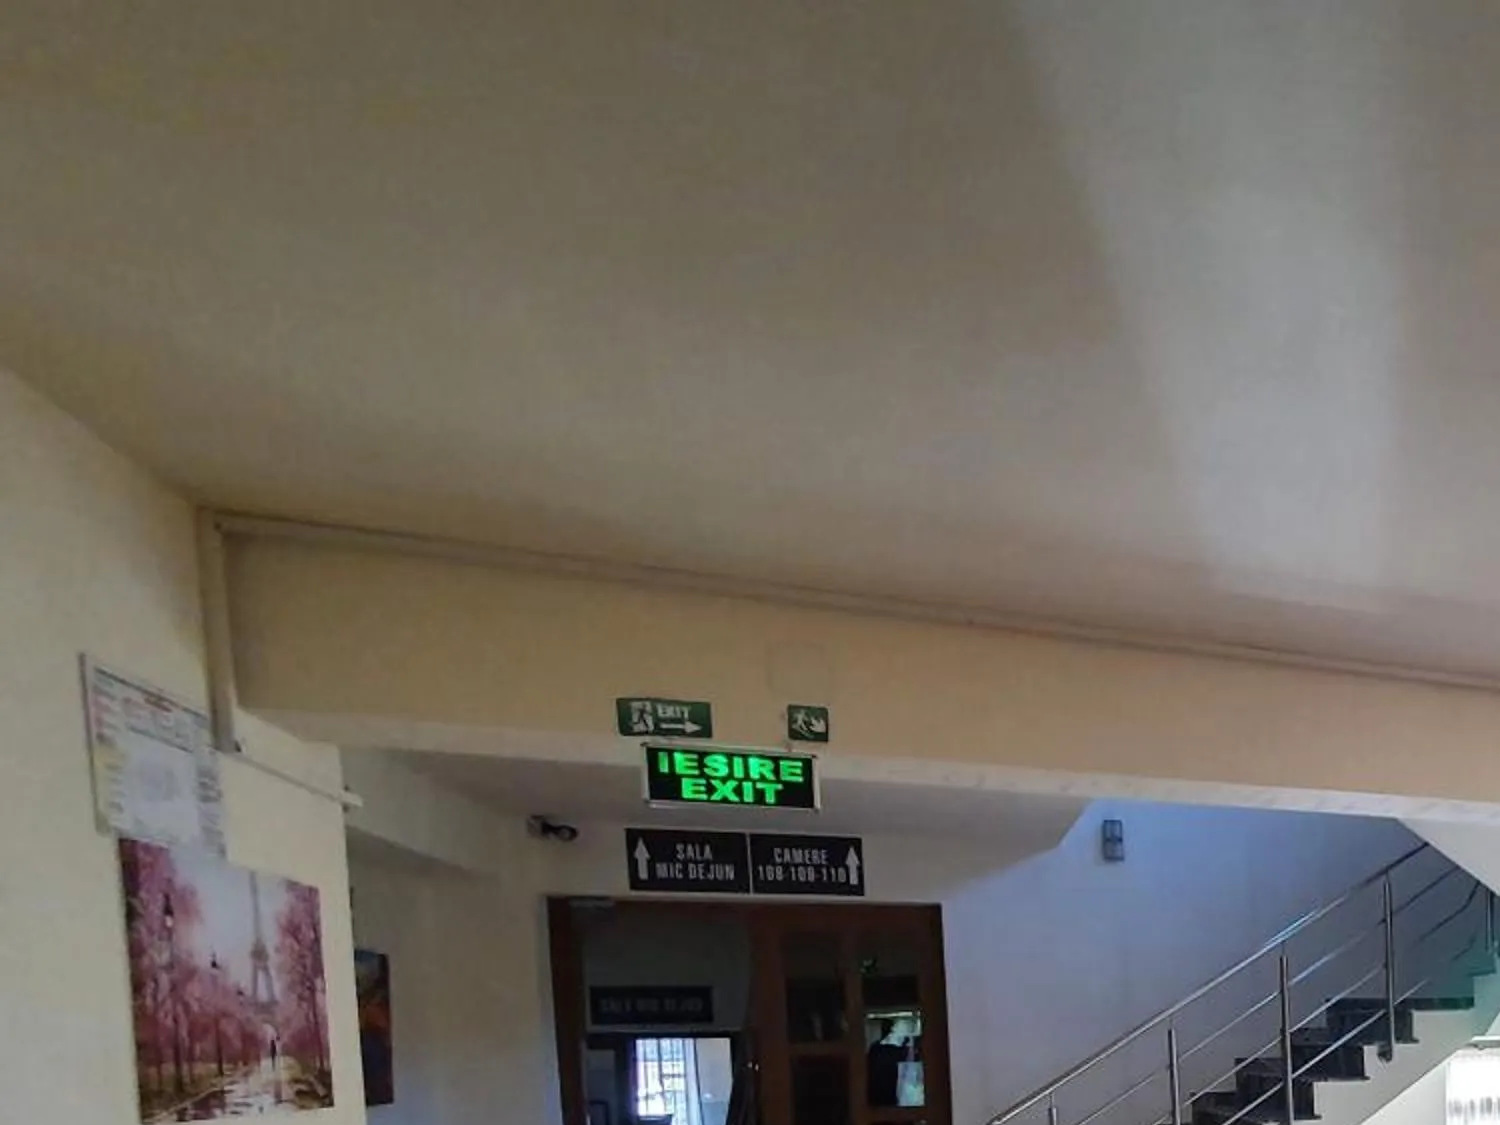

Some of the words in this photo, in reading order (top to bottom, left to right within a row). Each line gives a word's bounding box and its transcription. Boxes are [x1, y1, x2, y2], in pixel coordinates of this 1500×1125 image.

[656, 703, 691, 719] EXIT
[658, 750, 804, 782] IESIRE
[680, 777, 784, 804] EXIT
[675, 843, 713, 861] SALA
[773, 847, 829, 865] CAMERE
[655, 862, 684, 880] MIC
